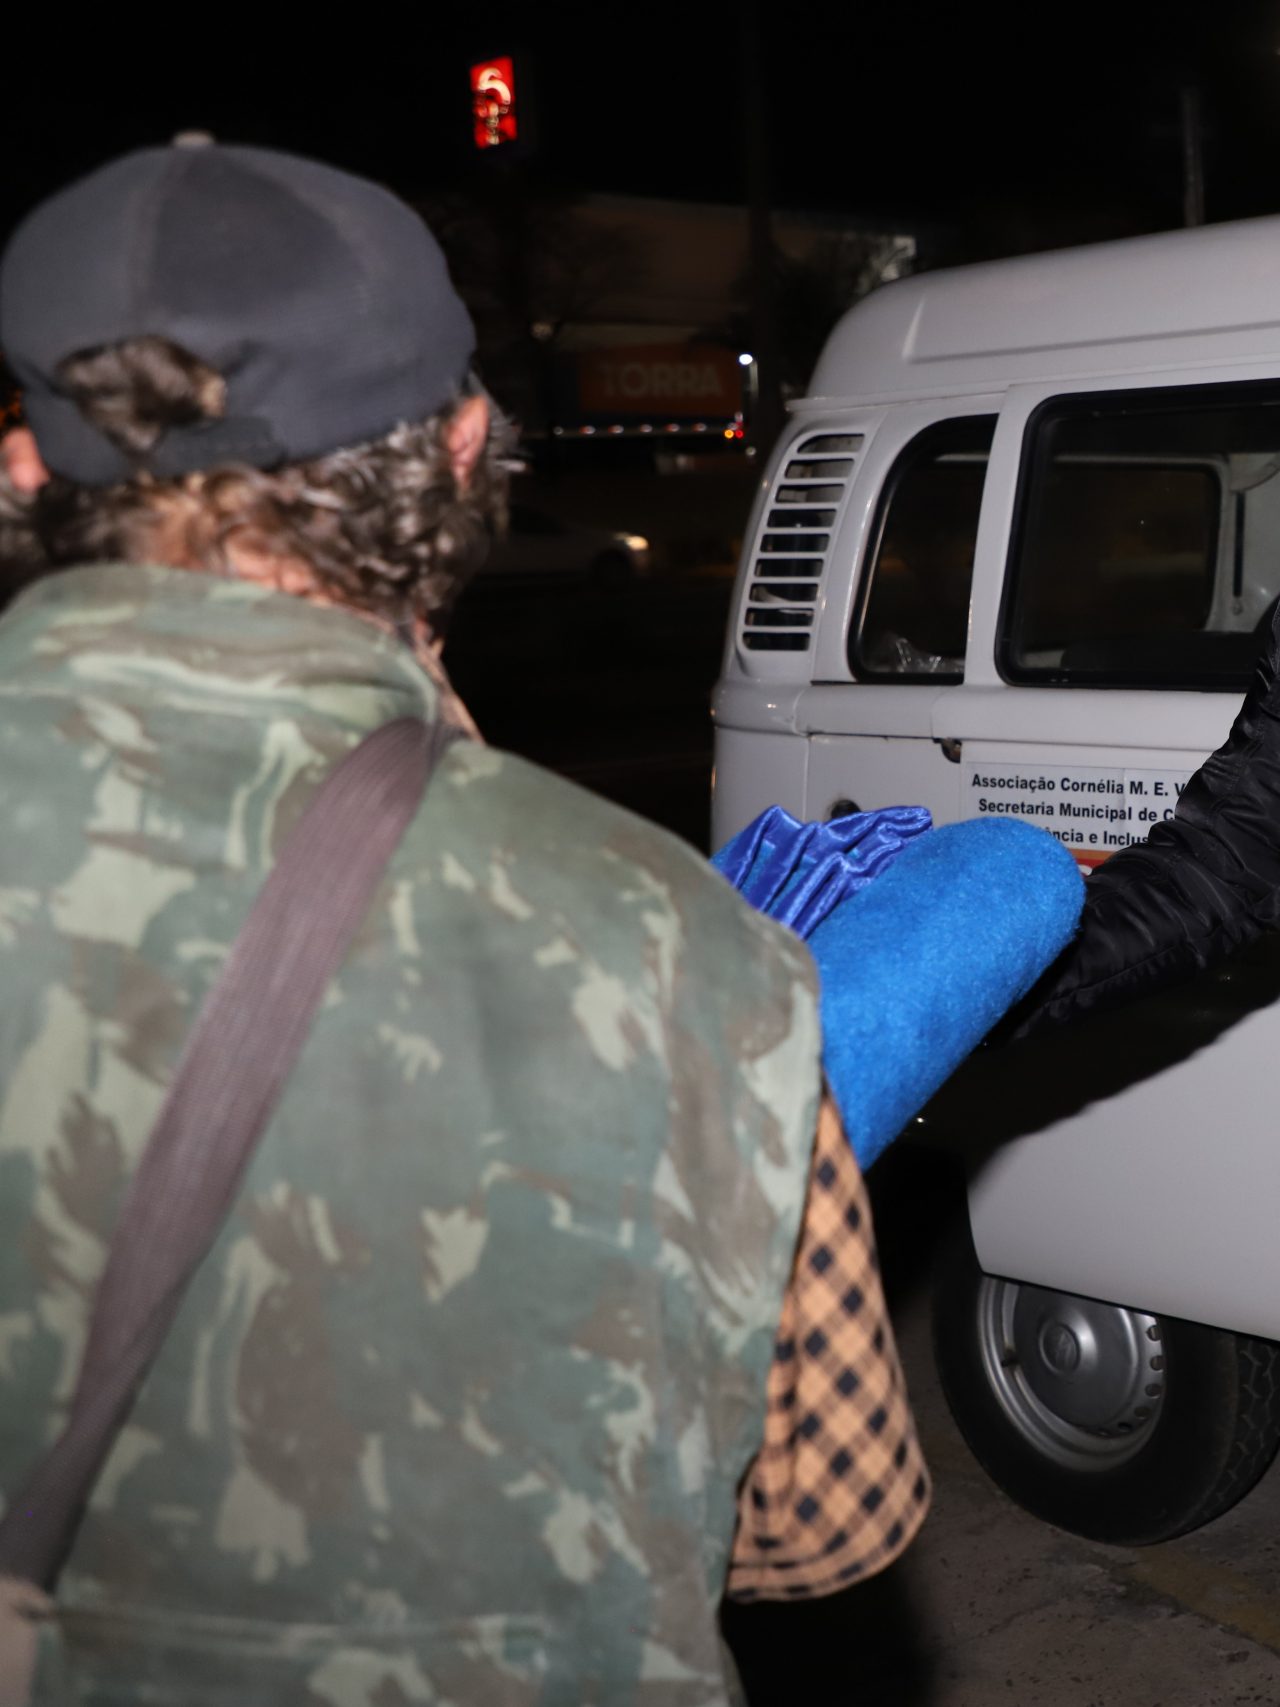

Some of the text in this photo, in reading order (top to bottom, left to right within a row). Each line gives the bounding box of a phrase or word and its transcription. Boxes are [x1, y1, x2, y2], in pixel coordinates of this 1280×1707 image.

[602, 363, 723, 397] TORRA
[971, 773, 1186, 796] Associação Cornélia M. E. V
[978, 798, 1054, 816] Secretaria
[1059, 803, 1132, 823] Municipal
[1138, 807, 1157, 822] de
[1046, 827, 1149, 846] ncia e Inclus
